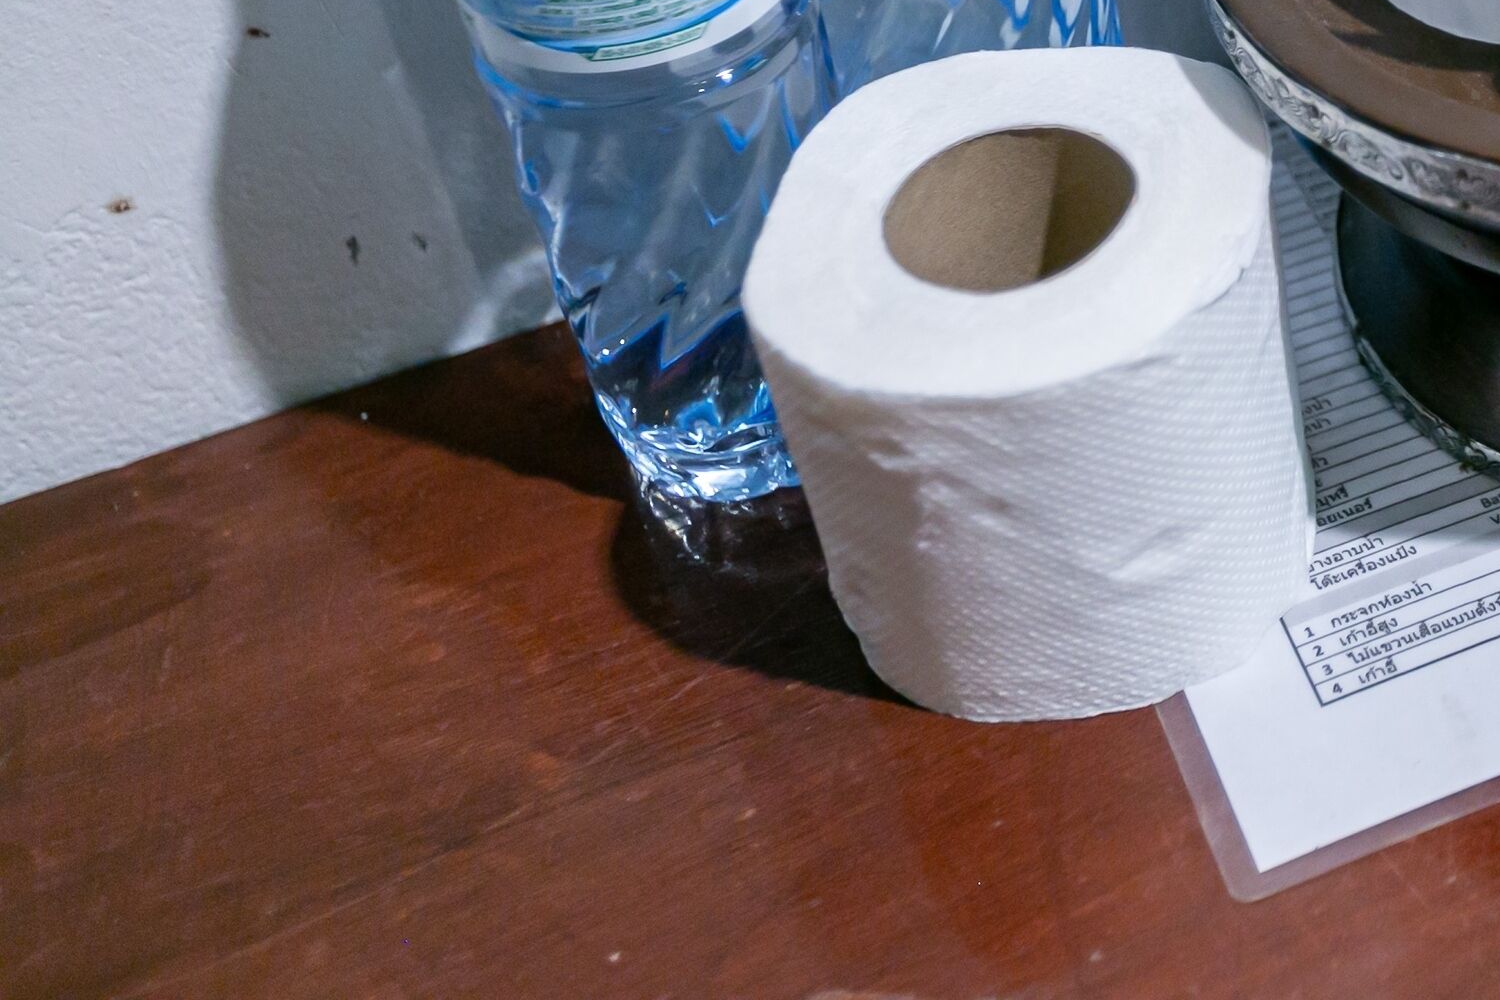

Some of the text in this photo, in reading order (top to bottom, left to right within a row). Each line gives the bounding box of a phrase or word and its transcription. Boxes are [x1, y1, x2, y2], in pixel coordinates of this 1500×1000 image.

[1304, 627, 1315, 639] 1
[1331, 580, 1432, 629] กระจกห้องน้ำ
[1312, 645, 1324, 657] 2
[1322, 664, 1334, 676] 3
[1332, 683, 1343, 695] 4
[1358, 654, 1398, 684] เก้าอี้
